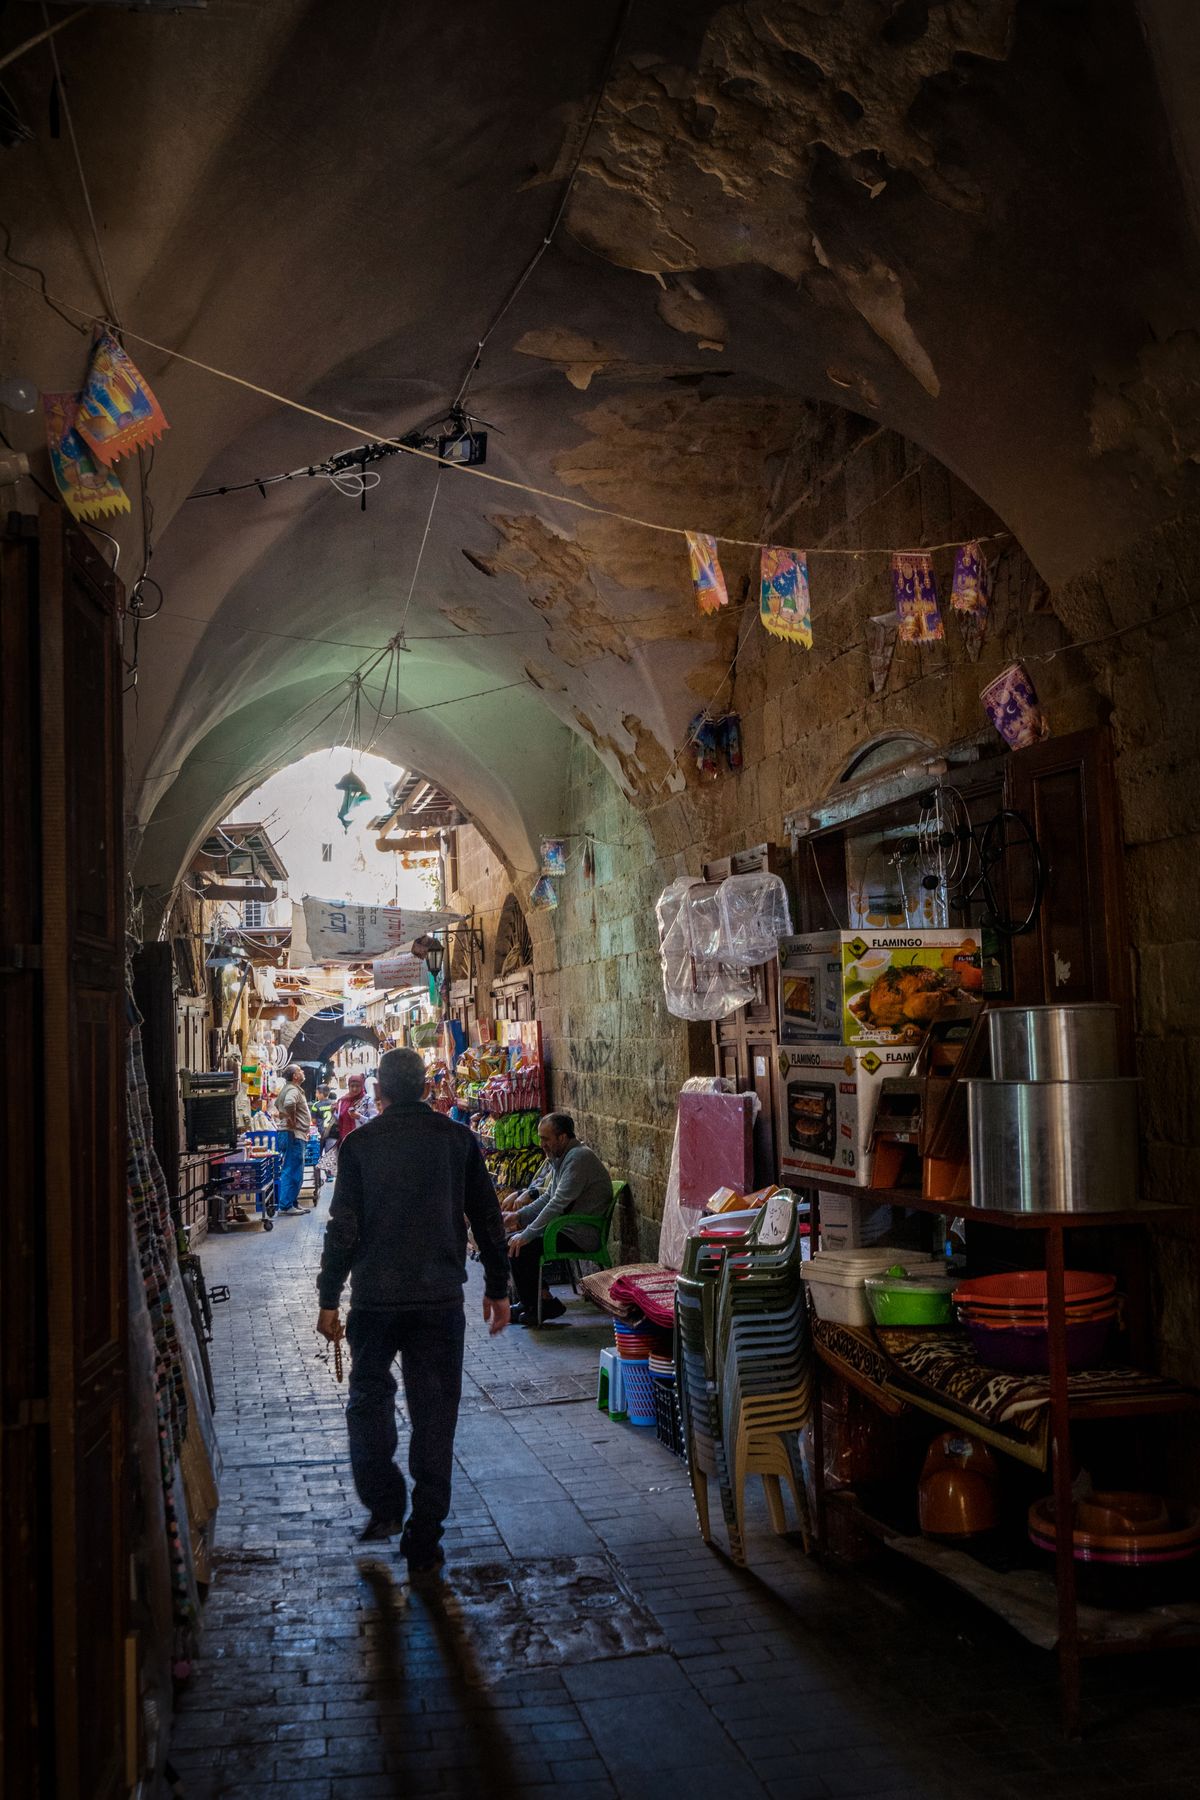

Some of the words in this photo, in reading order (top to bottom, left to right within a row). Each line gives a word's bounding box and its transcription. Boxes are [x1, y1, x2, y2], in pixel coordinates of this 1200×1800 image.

[872, 938, 922, 947] FLAMINGO
[791, 1053, 821, 1065] FLAMINGO
[886, 1052, 914, 1061] FLAMI
